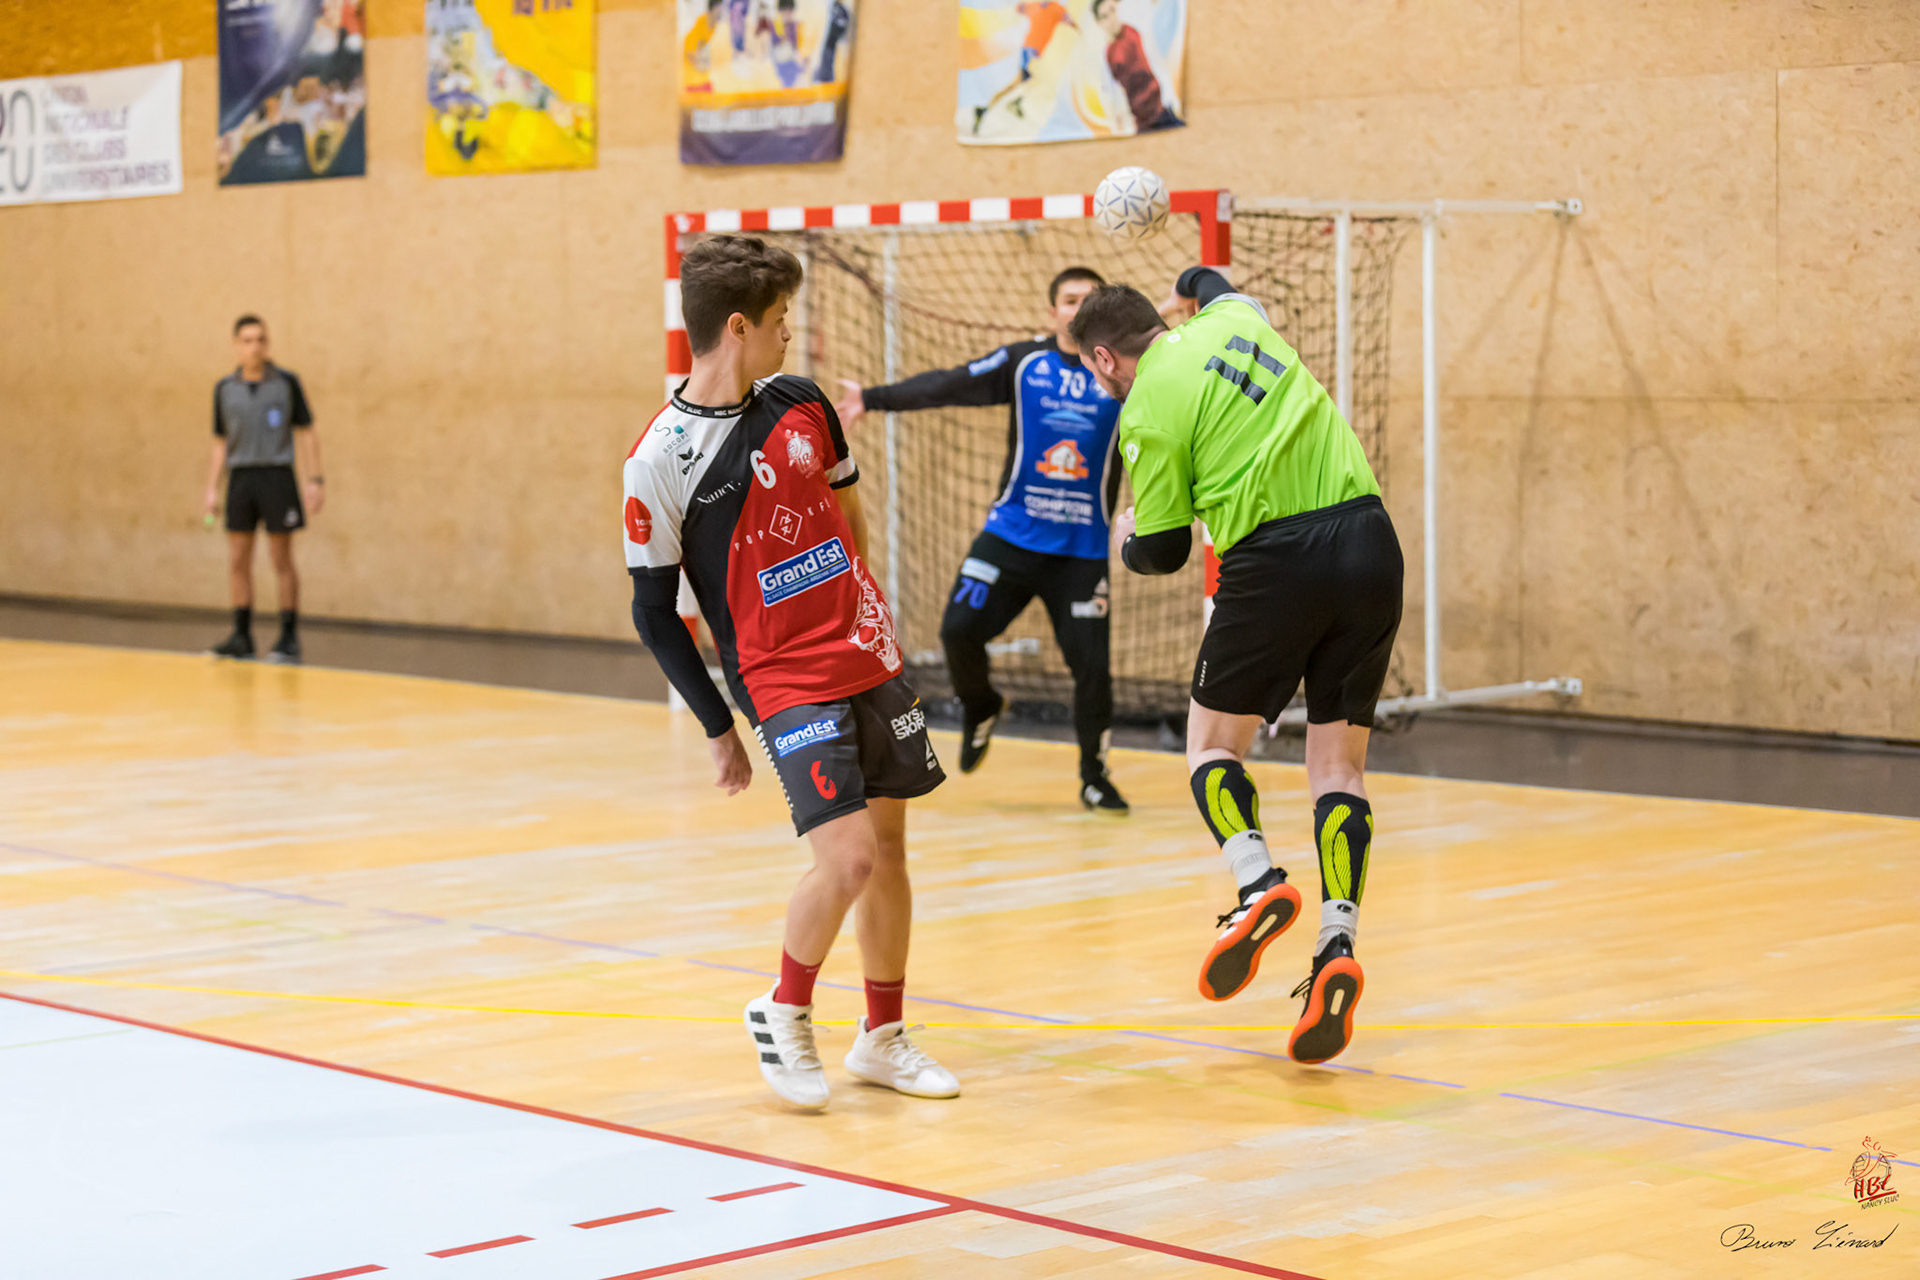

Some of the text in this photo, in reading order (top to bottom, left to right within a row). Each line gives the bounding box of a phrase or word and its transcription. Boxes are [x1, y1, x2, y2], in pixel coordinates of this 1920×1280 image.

[1059, 368, 1087, 399] 70
[1204, 335, 1287, 405] 11
[750, 449, 777, 489] 6
[954, 577, 989, 609] 70
[810, 760, 838, 800] 6
